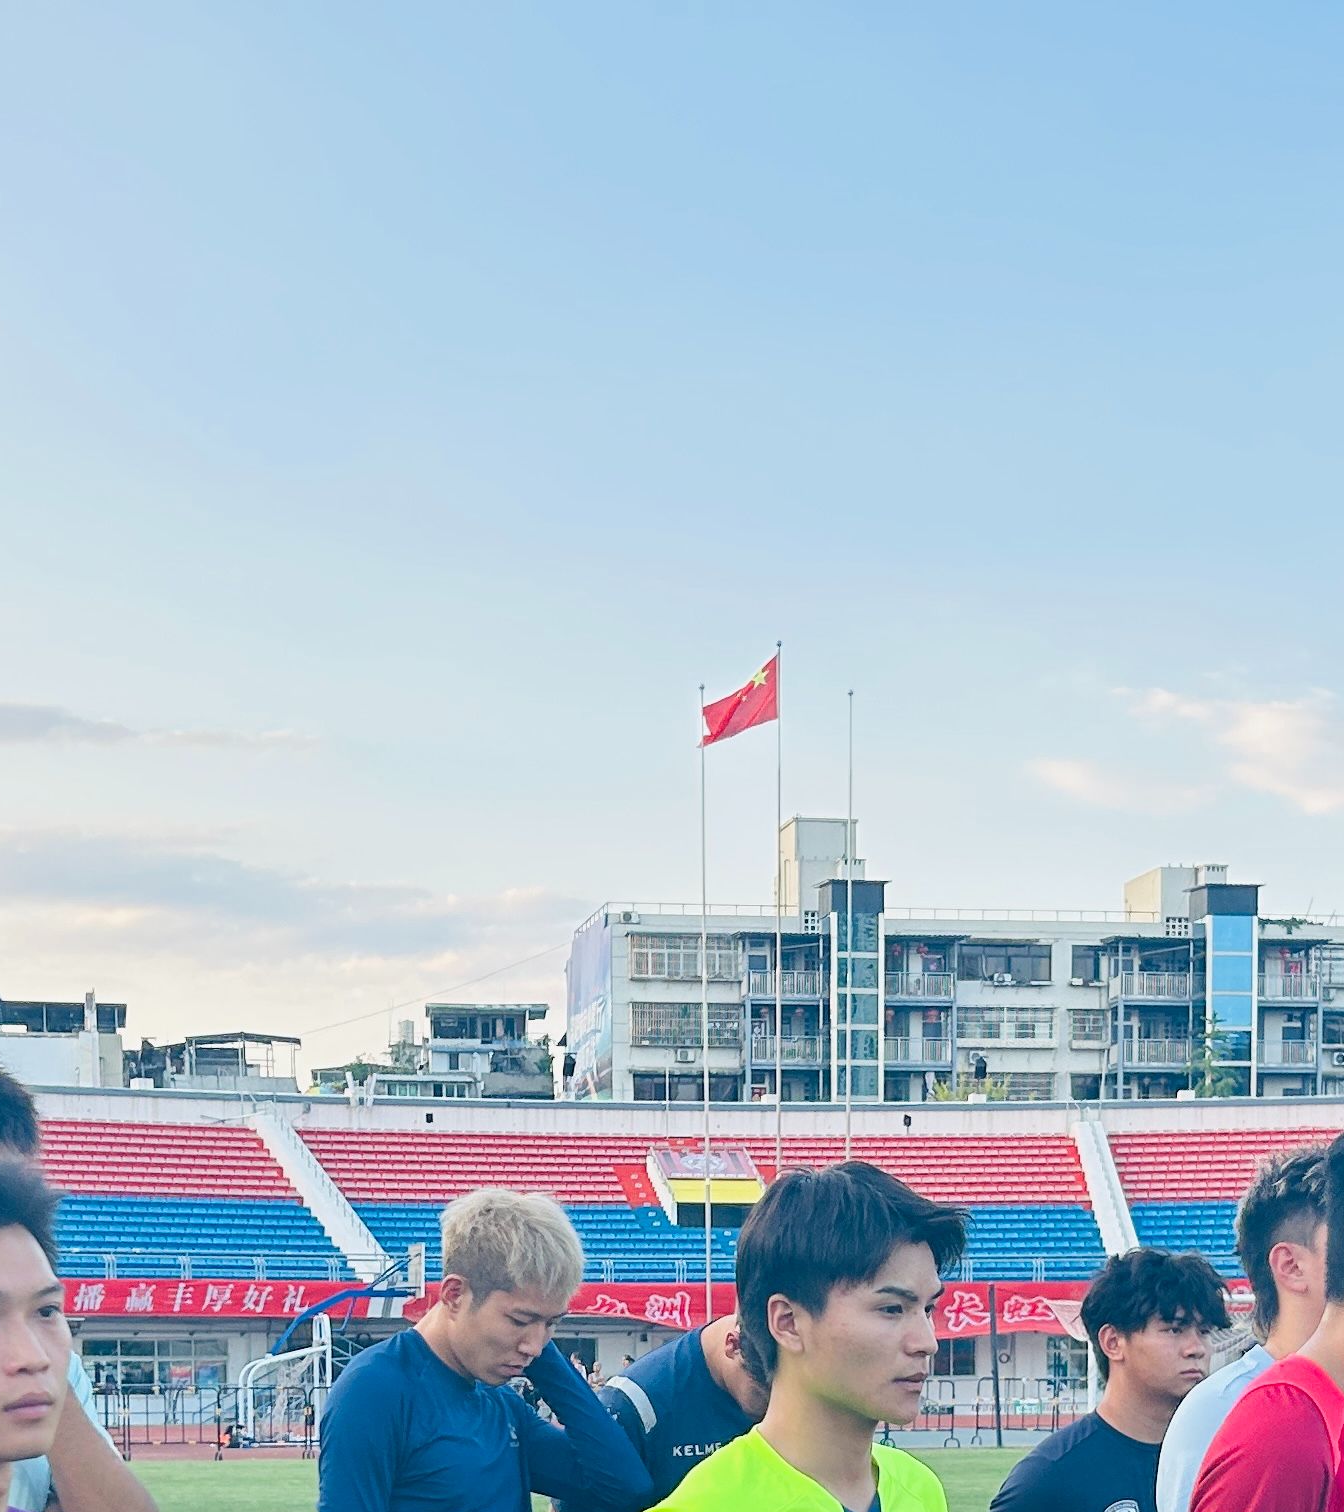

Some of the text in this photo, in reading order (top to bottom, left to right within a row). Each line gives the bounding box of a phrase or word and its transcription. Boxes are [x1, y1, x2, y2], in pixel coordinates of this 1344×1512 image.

[123, 1283, 313, 1313] 赢丰厚好礼
[672, 1443, 722, 1457] KELME
